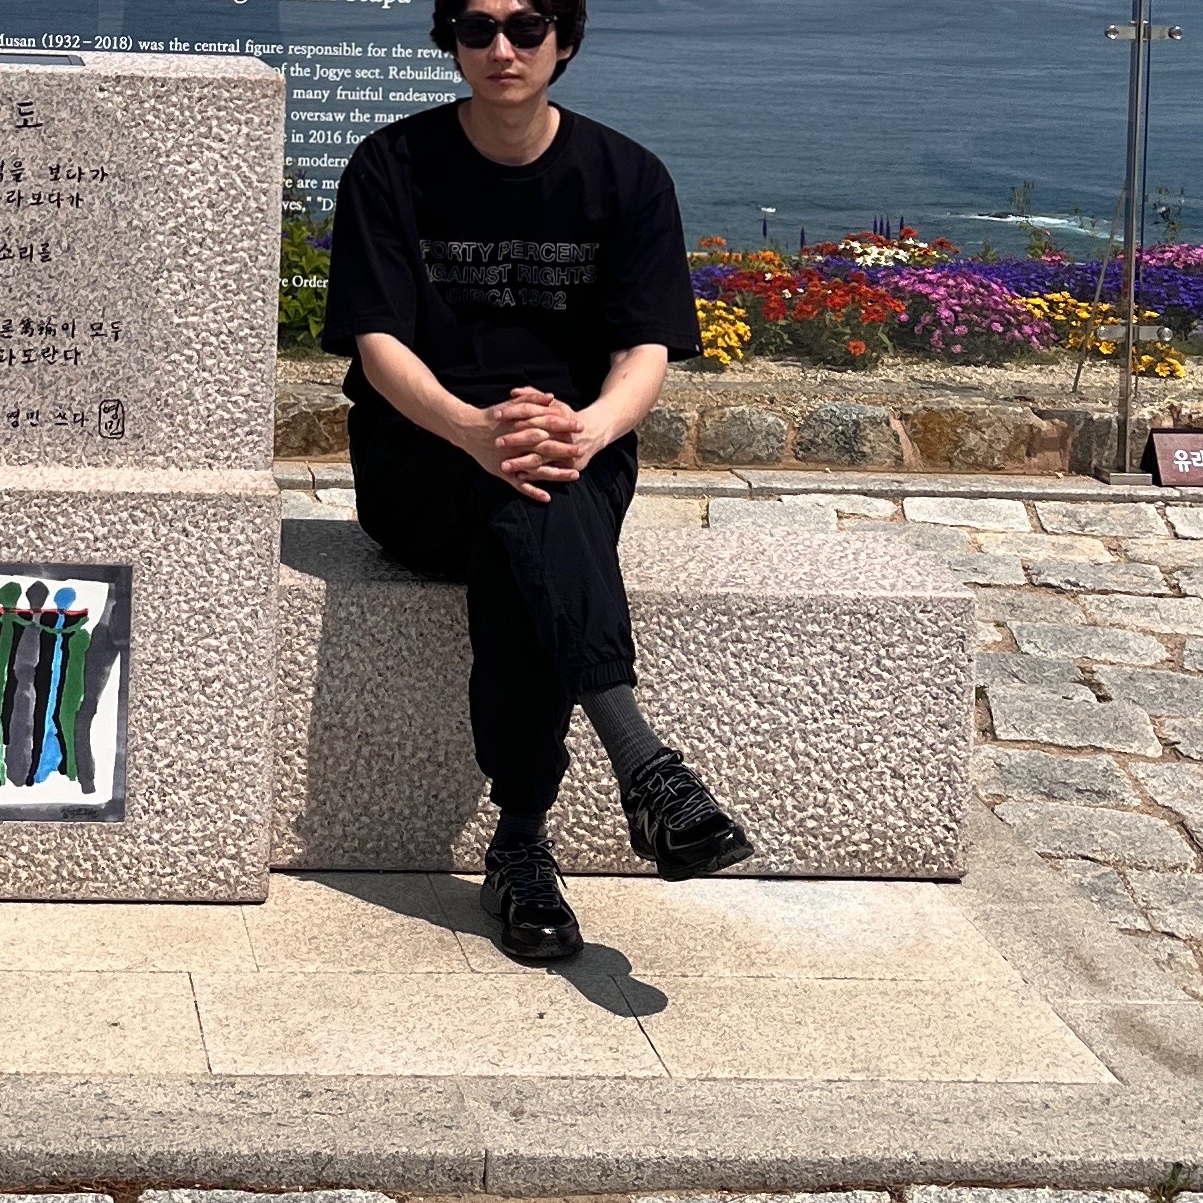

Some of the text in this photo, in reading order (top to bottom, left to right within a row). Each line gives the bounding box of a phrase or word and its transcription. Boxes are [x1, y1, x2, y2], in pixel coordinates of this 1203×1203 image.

[138, 39, 164, 51] was
[169, 36, 190, 52] the
[194, 39, 240, 53] central
[245, 39, 283, 56] figure
[288, 42, 362, 59] responsible
[367, 43, 387, 57] for
[392, 43, 413, 58] the
[290, 63, 310, 77] the
[314, 64, 351, 81] Jogye
[355, 66, 384, 79] sect.
[388, 66, 462, 83] Rebuilding
[292, 86, 456, 102] many fruitful endeavors
[290, 108, 410, 123] oversaw the man
[291, 130, 304, 143] in
[308, 130, 342, 144] 2016
[48, 163, 108, 183] 보다가
[296, 178, 318, 189] are
[419, 239, 599, 263] FORTY PERCENT
[292, 275, 328, 288] Order
[517, 263, 597, 286] RIGHTS
[446, 287, 567, 310] CIRCA 1992
[89, 320, 123, 342] 모두
[54, 412, 89, 427] 쓰다
